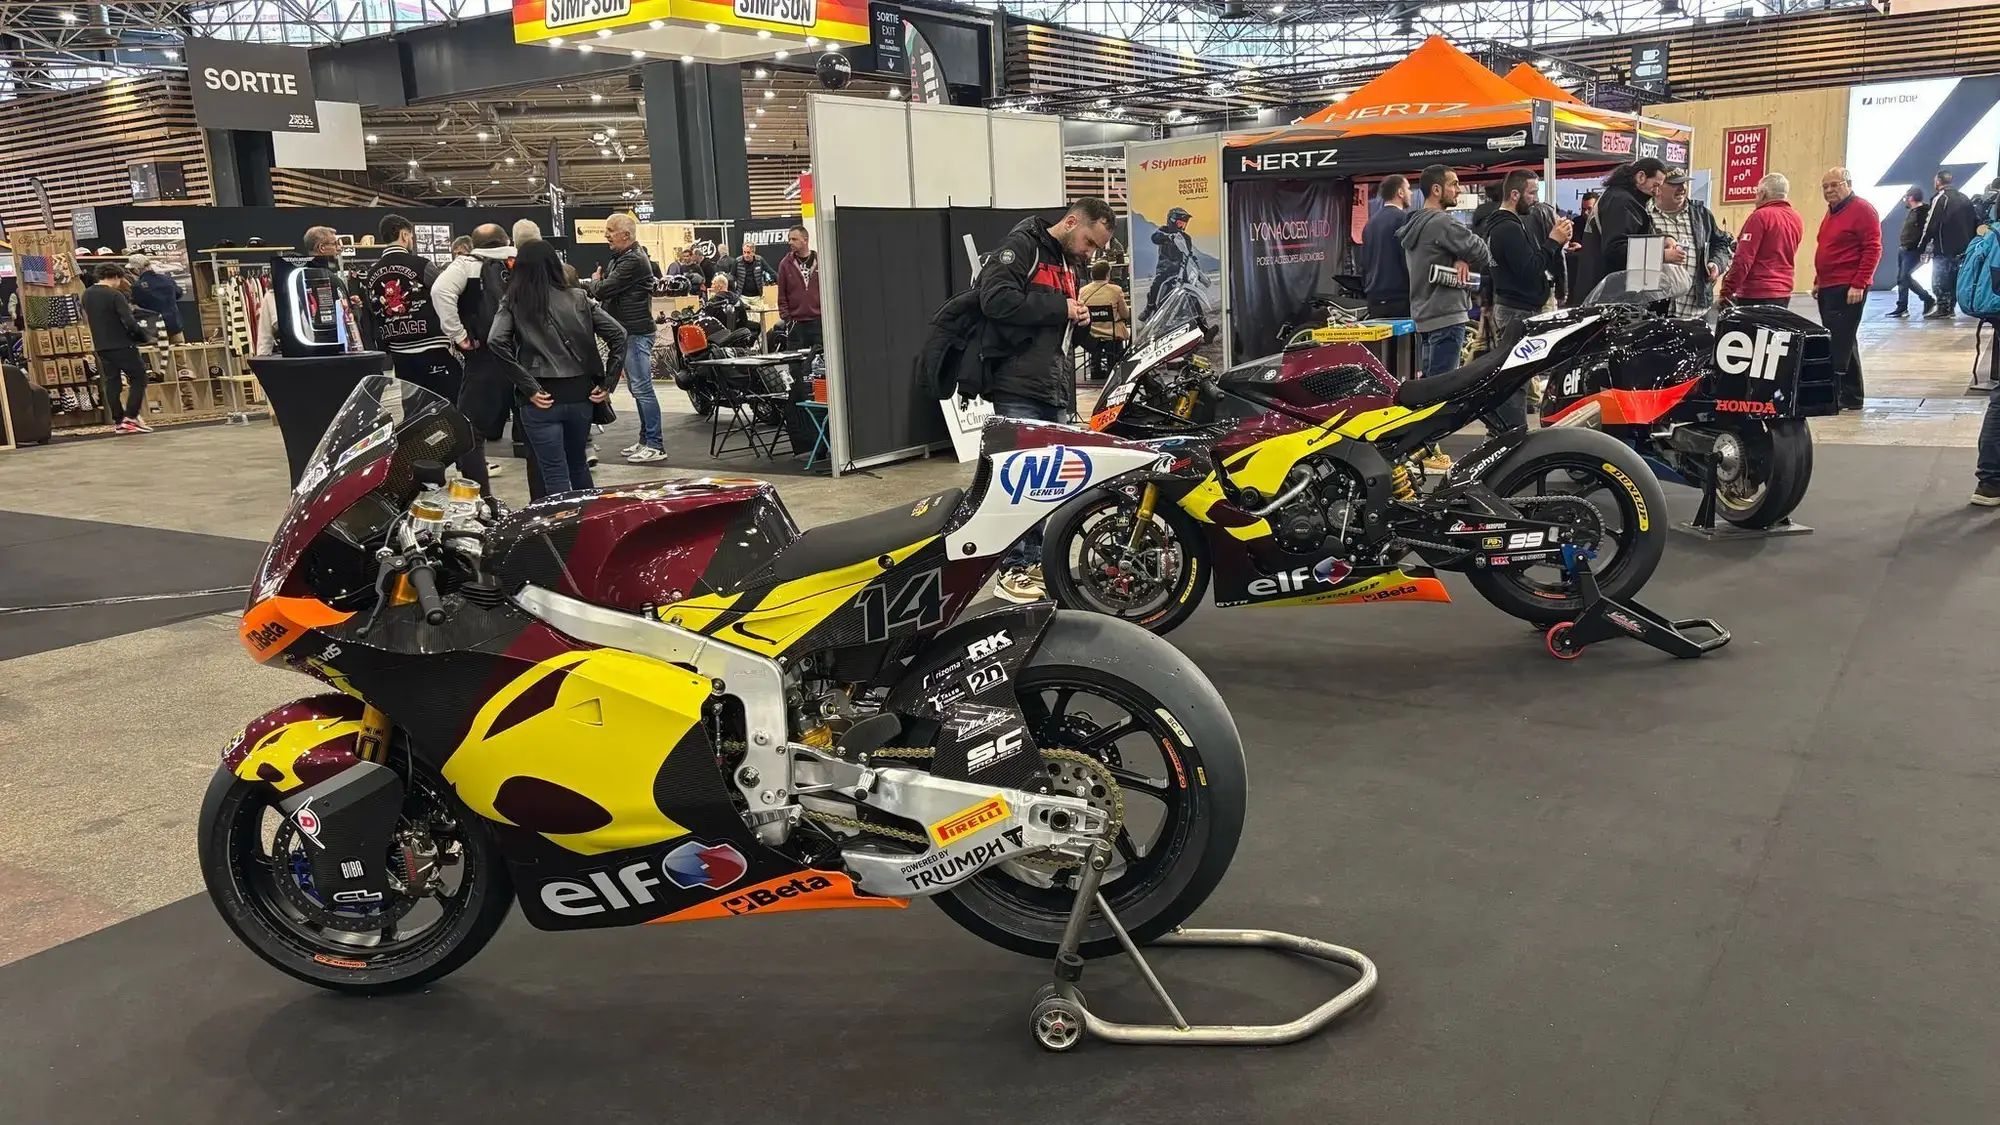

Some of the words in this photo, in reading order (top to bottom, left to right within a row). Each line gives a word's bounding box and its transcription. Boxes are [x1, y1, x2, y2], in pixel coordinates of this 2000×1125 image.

[877, 11, 900, 24] SORTIE
[881, 25, 896, 36] EXIT
[204, 67, 298, 95] SORTIE
[1875, 96, 1897, 105] John
[1899, 94, 1918, 103] Doe
[1325, 103, 1470, 123] HERTZ
[1730, 133, 1761, 144] JOHN
[1408, 146, 1472, 158] www.hertz-audio.com
[1735, 143, 1757, 155] DOE
[1151, 155, 1207, 171] Stylmartin
[1241, 149, 1338, 173] HERTZ
[1731, 157, 1758, 166] MADE
[1179, 182, 1208, 190] PROTECT
[1733, 169, 1751, 183] FOR
[1728, 186, 1758, 195] RIDERS
[125, 225, 182, 237] Speedster
[379, 320, 428, 340] PALACE
[1716, 328, 1792, 381] elf
[1563, 368, 1581, 396] elf
[1715, 399, 1777, 414] HONDA
[1011, 446, 1068, 505] NL
[1029, 488, 1065, 497] GENEVA
[1613, 470, 1647, 524] DUNLOP
[1508, 532, 1545, 549] 99
[1247, 567, 1310, 596] elf
[1315, 581, 1380, 601] DUNLOP
[1377, 585, 1417, 601] Beta
[853, 566, 955, 644] 14
[249, 621, 289, 651] Beta
[967, 629, 1013, 659] RK
[935, 661, 961, 680] rizoma
[967, 727, 1023, 768] SC
[968, 746, 1022, 772] PROJECT
[937, 801, 1003, 841] PIRELLI
[340, 860, 364, 879] BIBA
[900, 854, 938, 875] POWERED
[938, 849, 949, 860] BY
[906, 838, 1006, 890] TRIUMPH
[540, 862, 660, 916] elf
[746, 875, 833, 907] Beta
